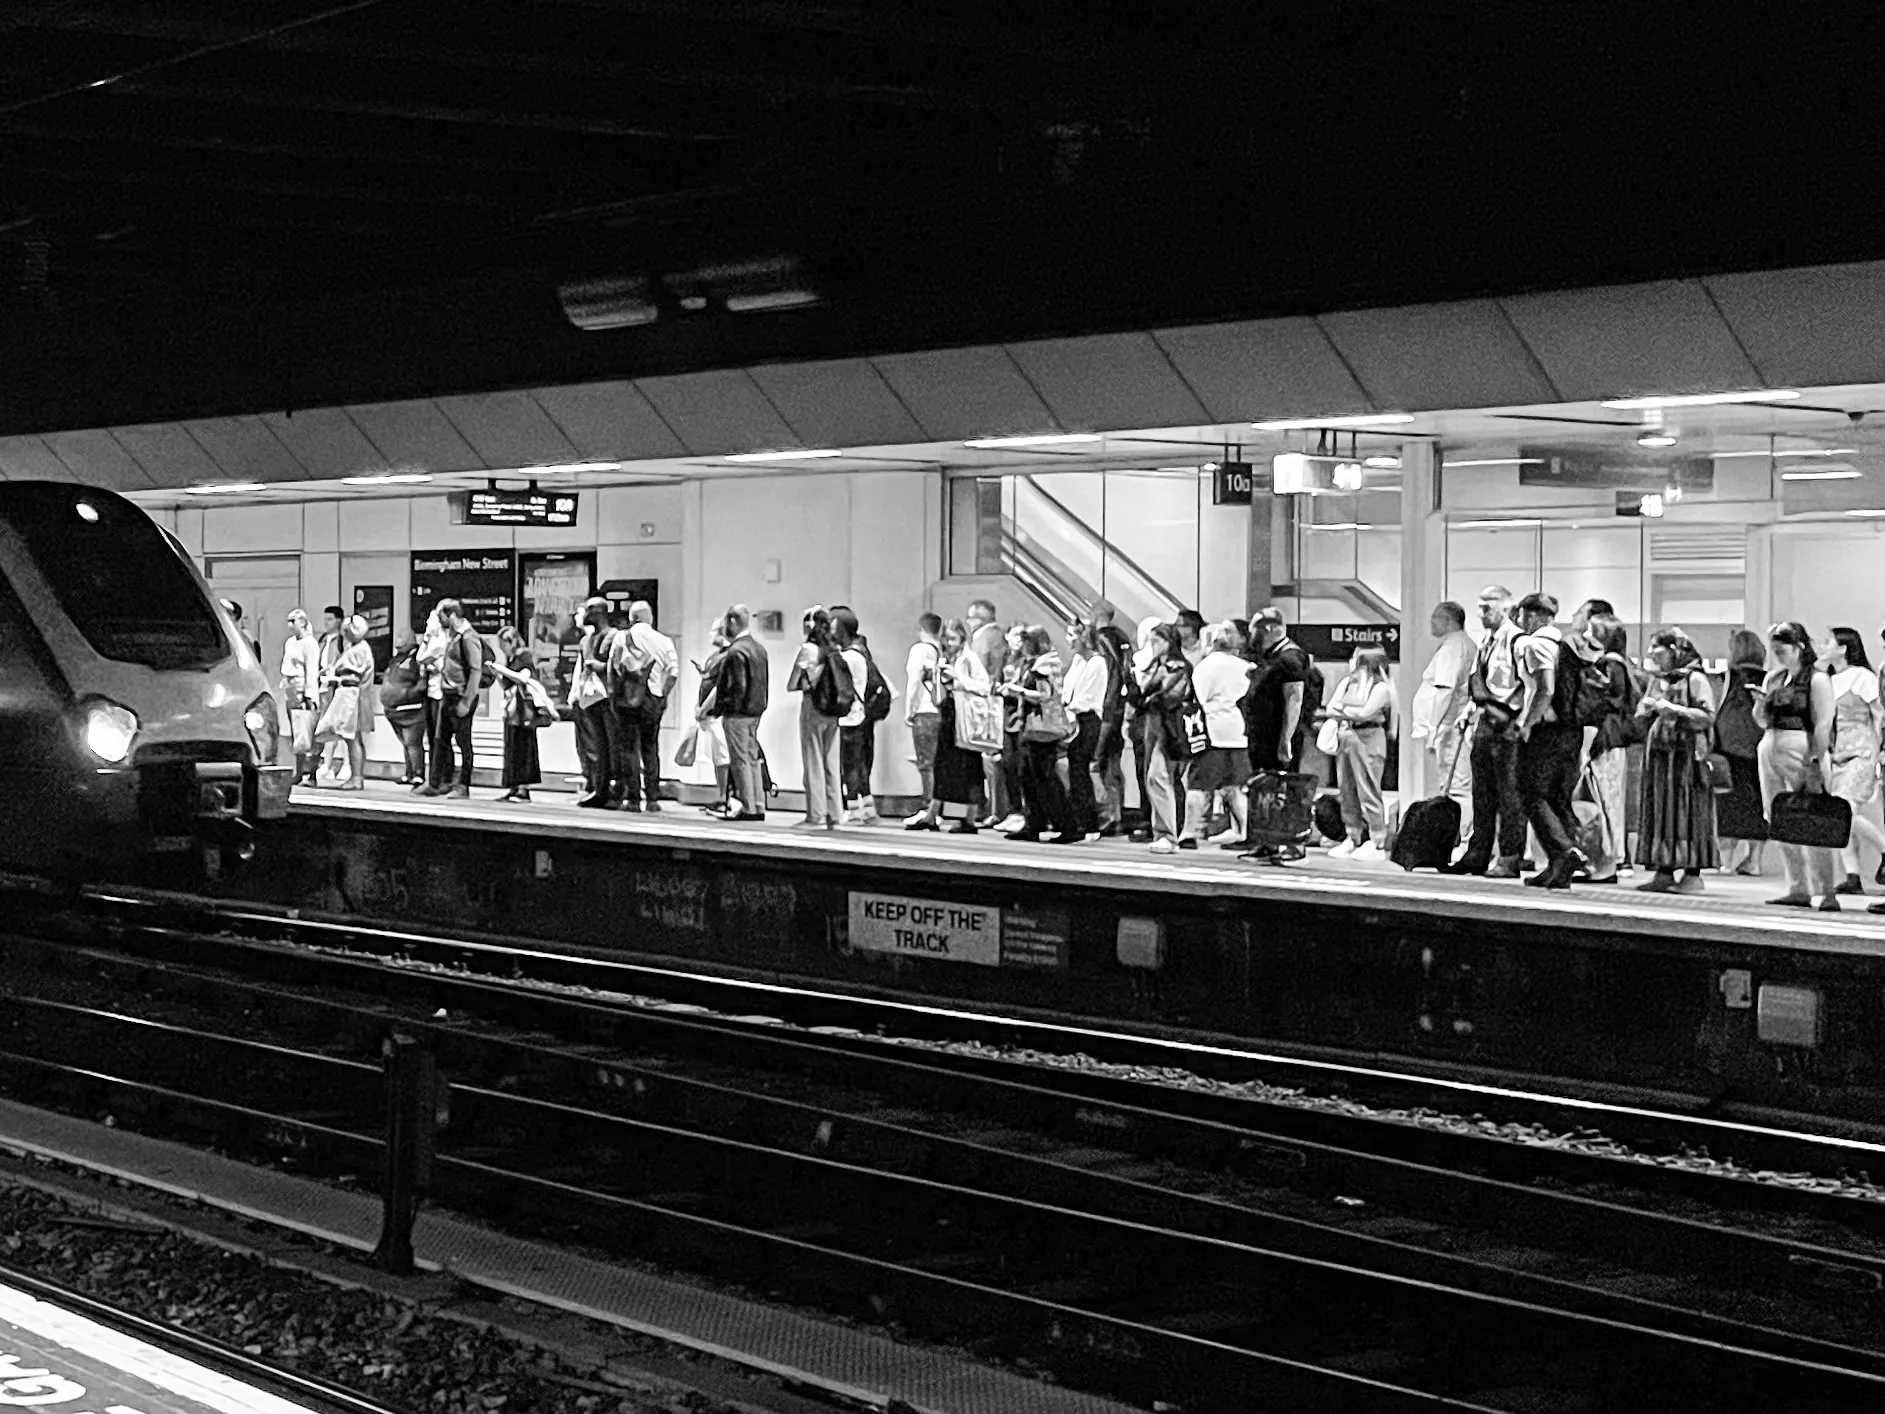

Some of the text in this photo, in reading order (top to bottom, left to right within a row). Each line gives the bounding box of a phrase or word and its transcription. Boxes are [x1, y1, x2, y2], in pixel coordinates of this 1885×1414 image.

[1345, 628, 1383, 643] Stairs
[864, 900, 906, 922] KEEP
[911, 906, 944, 926] OFF
[948, 910, 982, 931] THE
[894, 929, 950, 953] TRACK
